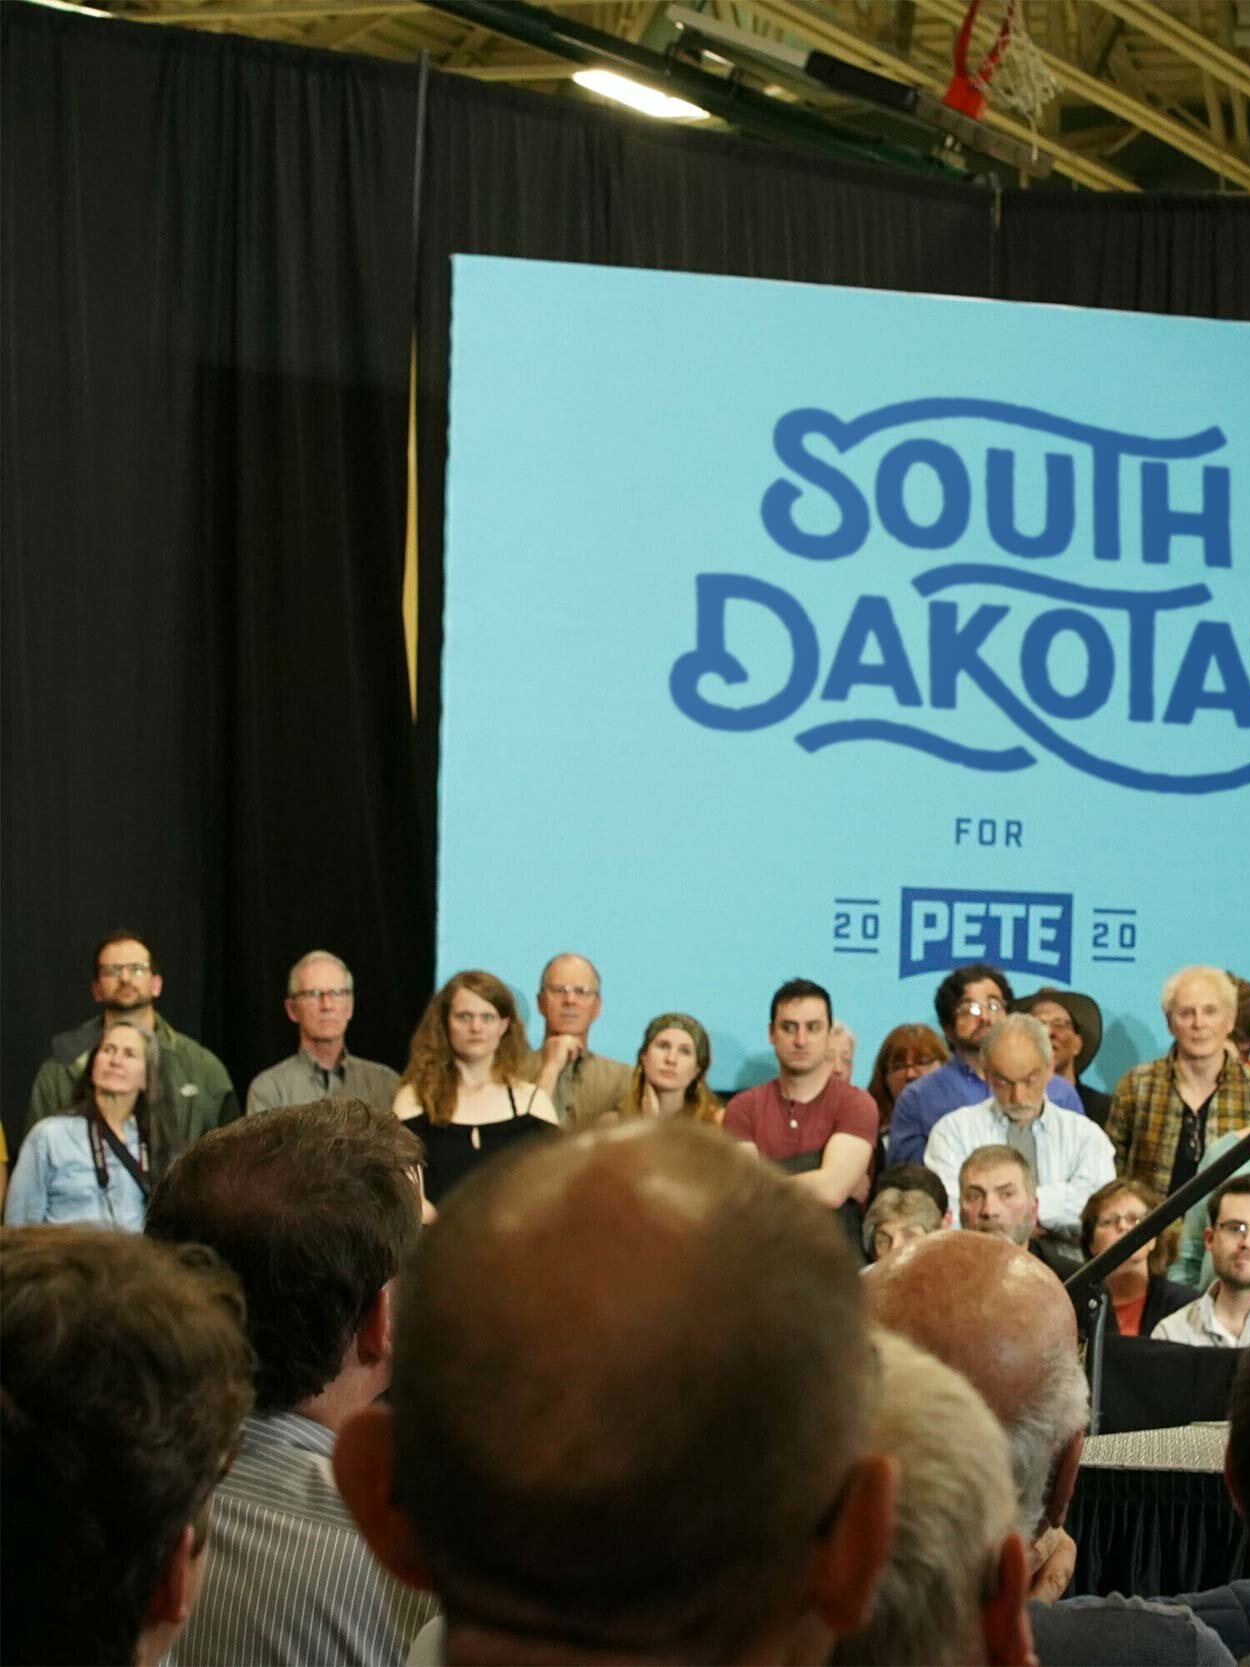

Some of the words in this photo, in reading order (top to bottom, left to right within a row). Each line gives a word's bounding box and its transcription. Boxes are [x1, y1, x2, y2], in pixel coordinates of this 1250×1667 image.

[761, 397, 1232, 568] SOUTH
[955, 818, 1023, 848] FOR
[834, 913, 880, 940] 20
[911, 900, 1064, 966] PETE
[1092, 923, 1137, 950] 20
